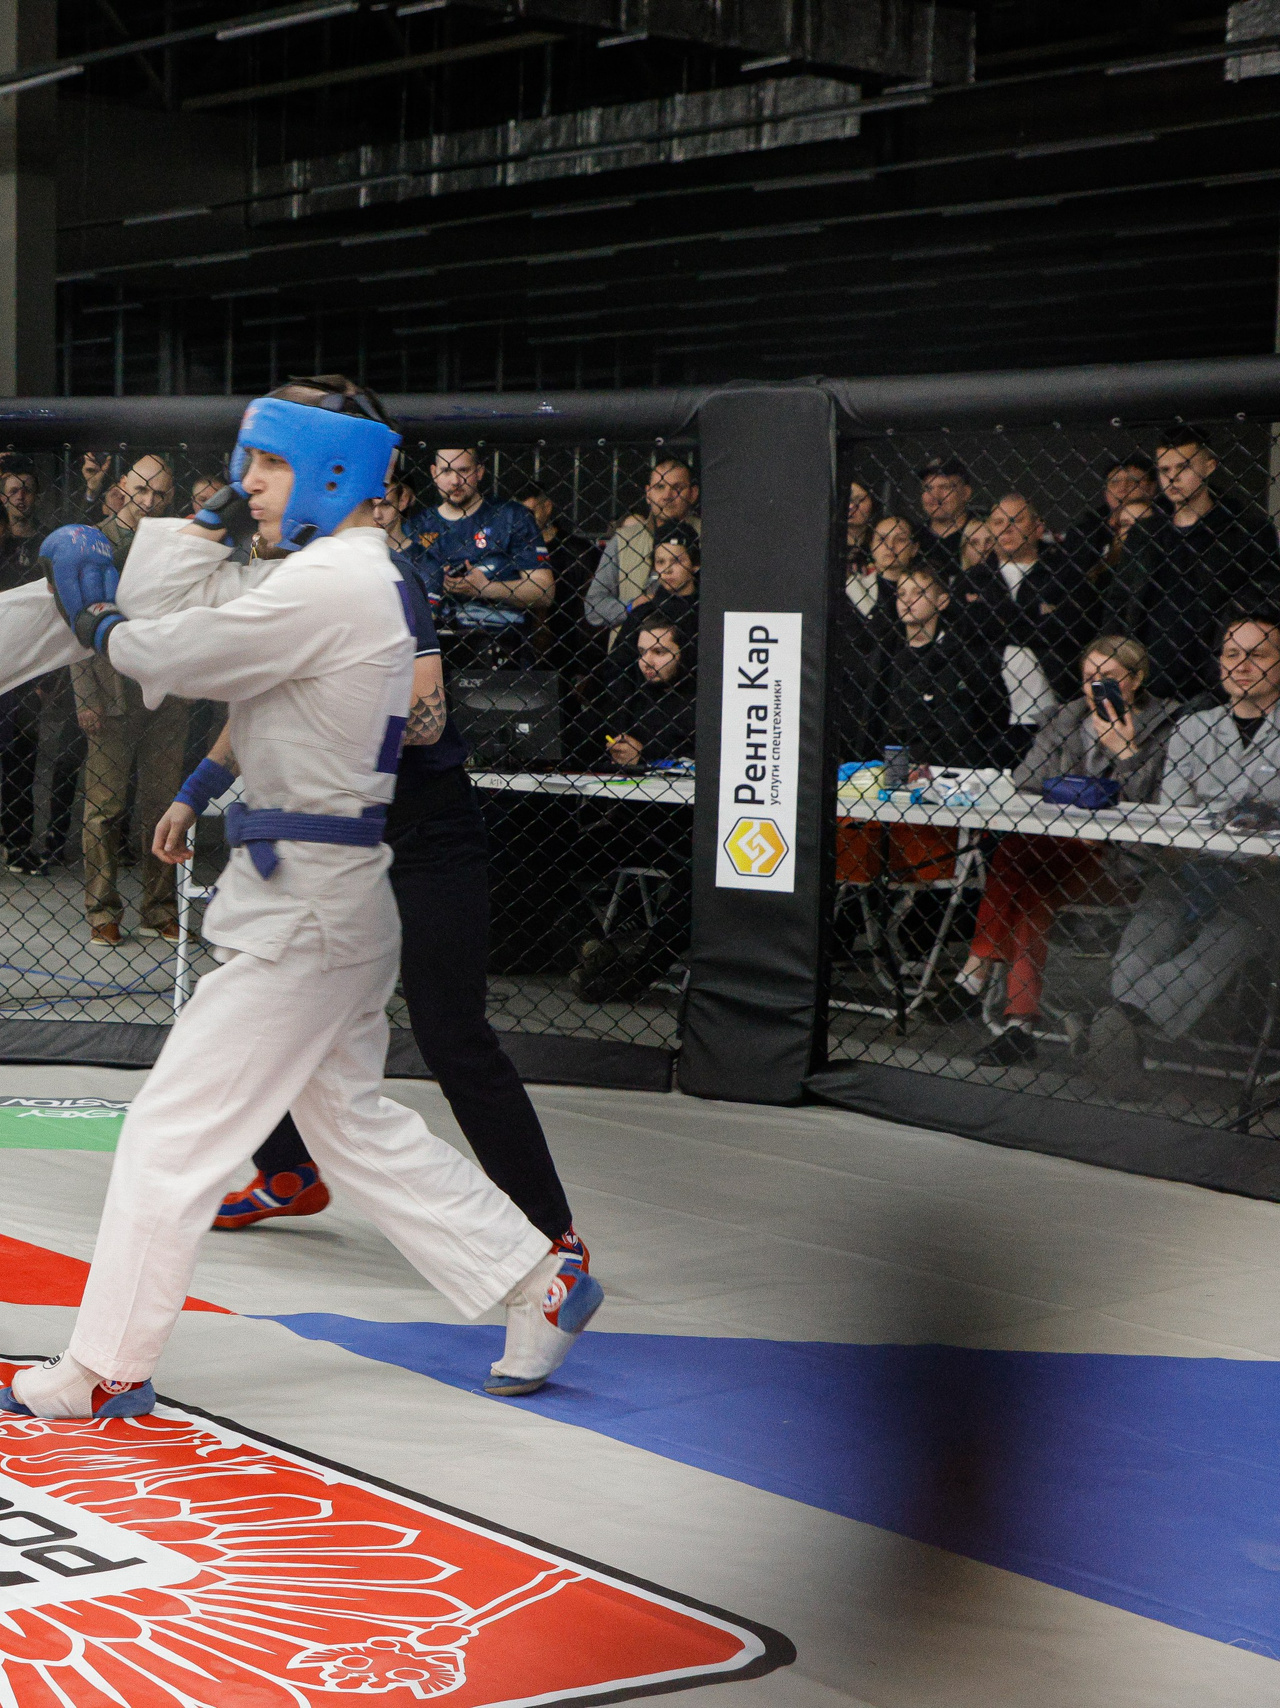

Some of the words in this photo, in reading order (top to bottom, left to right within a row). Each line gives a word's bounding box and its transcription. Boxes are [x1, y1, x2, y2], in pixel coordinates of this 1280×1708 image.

[736, 624, 779, 690] Кар
[733, 704, 769, 806] Рента
[771, 679, 782, 761] спецтехники
[770, 764, 781, 806] услуги
